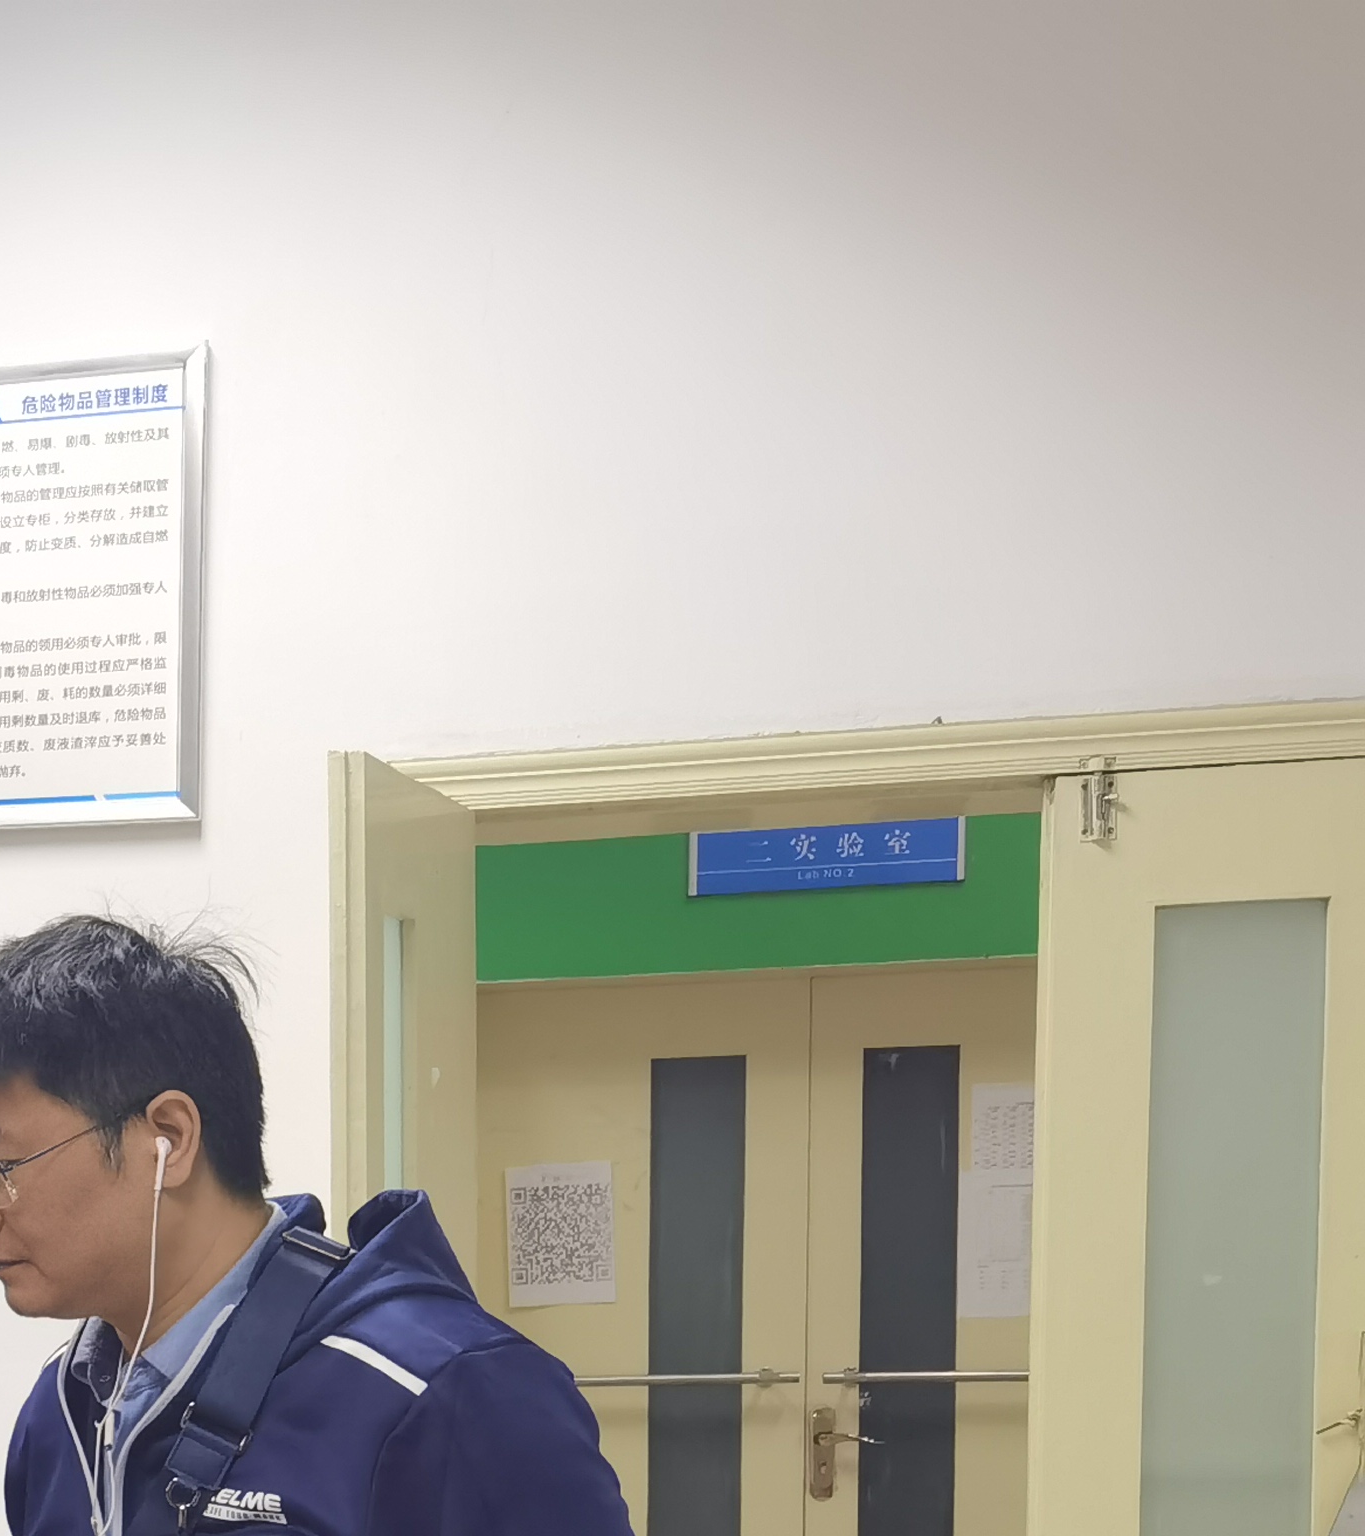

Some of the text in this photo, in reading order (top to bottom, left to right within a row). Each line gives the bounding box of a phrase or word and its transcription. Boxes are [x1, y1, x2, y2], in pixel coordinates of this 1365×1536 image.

[21, 383, 169, 416] 危险物品管理制度
[745, 829, 911, 863] 二实验室
[797, 870, 820, 880] Lab
[211, 1487, 282, 1512] ELME
